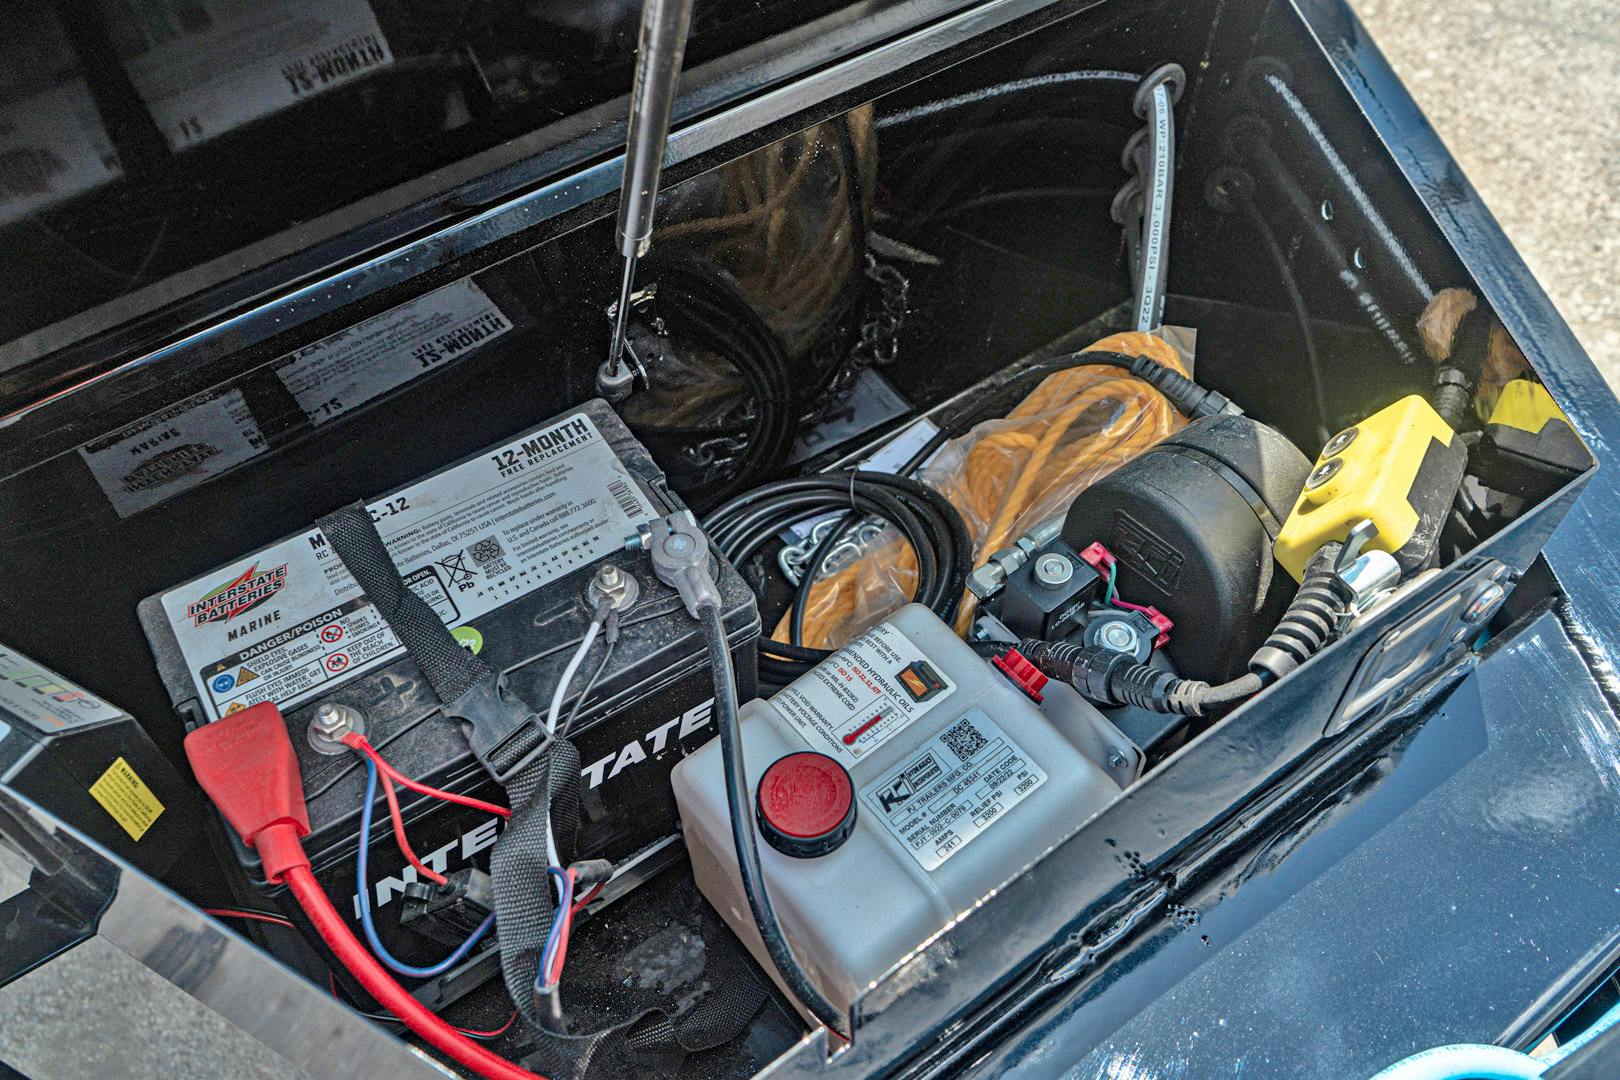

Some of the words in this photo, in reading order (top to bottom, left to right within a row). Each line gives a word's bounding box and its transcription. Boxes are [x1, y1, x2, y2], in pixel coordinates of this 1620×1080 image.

[490, 418, 589, 471] 12-MONTH
[499, 462, 525, 477] FREE
[526, 432, 593, 465] REPLACEMENT
[383, 527, 421, 547] WARNING:
[421, 519, 439, 531] Battery
[452, 502, 477, 516] terminals
[442, 514, 466, 527] California
[446, 518, 471, 532] California
[509, 520, 529, 533] replace
[527, 513, 545, 524] under
[506, 534, 518, 543] U.S.
[516, 528, 530, 538] and
[528, 519, 549, 532] Canada
[403, 547, 432, 564] Batteries,
[430, 538, 451, 551] Dallas,
[450, 534, 459, 542] TX
[457, 525, 478, 539] 75251
[477, 519, 492, 529] USA
[482, 557, 505, 570] BATTERY
[484, 564, 500, 575] MUST
[485, 564, 512, 580] RECYCLED
[187, 565, 287, 616] INTERSTATE
[418, 578, 434, 588] ACID
[457, 579, 475, 592] Pb
[194, 578, 284, 624] BATTERIES
[225, 609, 283, 642] MARINE
[339, 617, 350, 625] NO
[351, 622, 378, 637] SMOKING
[238, 607, 344, 661] DANGER/POISON
[346, 641, 363, 653] KEEP
[362, 634, 377, 645] OUT
[873, 635, 893, 653] BEFORE
[253, 652, 288, 672] EXPLOSIVE
[287, 642, 309, 656] GASES
[349, 648, 362, 658] THE
[362, 639, 384, 652] REACH
[864, 638, 877, 649] BEST
[874, 647, 889, 661] WITH
[246, 653, 270, 668] SHIELD
[260, 666, 273, 675] CAN
[272, 658, 291, 670] CAUSE
[290, 644, 321, 661] BLINDNESS
[836, 667, 848, 676] ISO
[851, 666, 861, 675] ISO
[244, 686, 266, 700] FLUSH
[266, 679, 283, 690] EYES
[282, 665, 311, 683] IMMEDI-
[266, 685, 285, 697] WITH
[307, 667, 322, 678] GET
[279, 686, 297, 698] HELP
[821, 678, 844, 699] EXTREME
[865, 667, 902, 700] HYDRAULIC
[897, 697, 914, 713] OILS
[778, 701, 797, 717] POWER
[797, 694, 812, 707] VOID
[796, 706, 819, 727] VOLTAGE
[813, 725, 844, 753] CONDITIONS
[982, 767, 1001, 782] DATE
[998, 754, 1018, 770] CODE
[1016, 769, 1029, 780] PSI
[952, 783, 965, 794] DC
[961, 770, 981, 787] 45341
[988, 768, 1015, 790] 09/22/22
[1016, 777, 1033, 792] 3200
[906, 804, 916, 813] PJ
[916, 780, 948, 805] TRAILERS
[945, 768, 964, 783] MFG.
[969, 798, 993, 817] RELIEF
[990, 789, 1003, 800] PSI
[905, 823, 930, 843] SERIAL
[928, 802, 957, 825] NUMBER
[980, 806, 998, 821] 3200
[898, 815, 922, 835] MODEL
[914, 835, 928, 847] PJT
[933, 828, 954, 845] AMPS
[942, 839, 956, 851] 241
